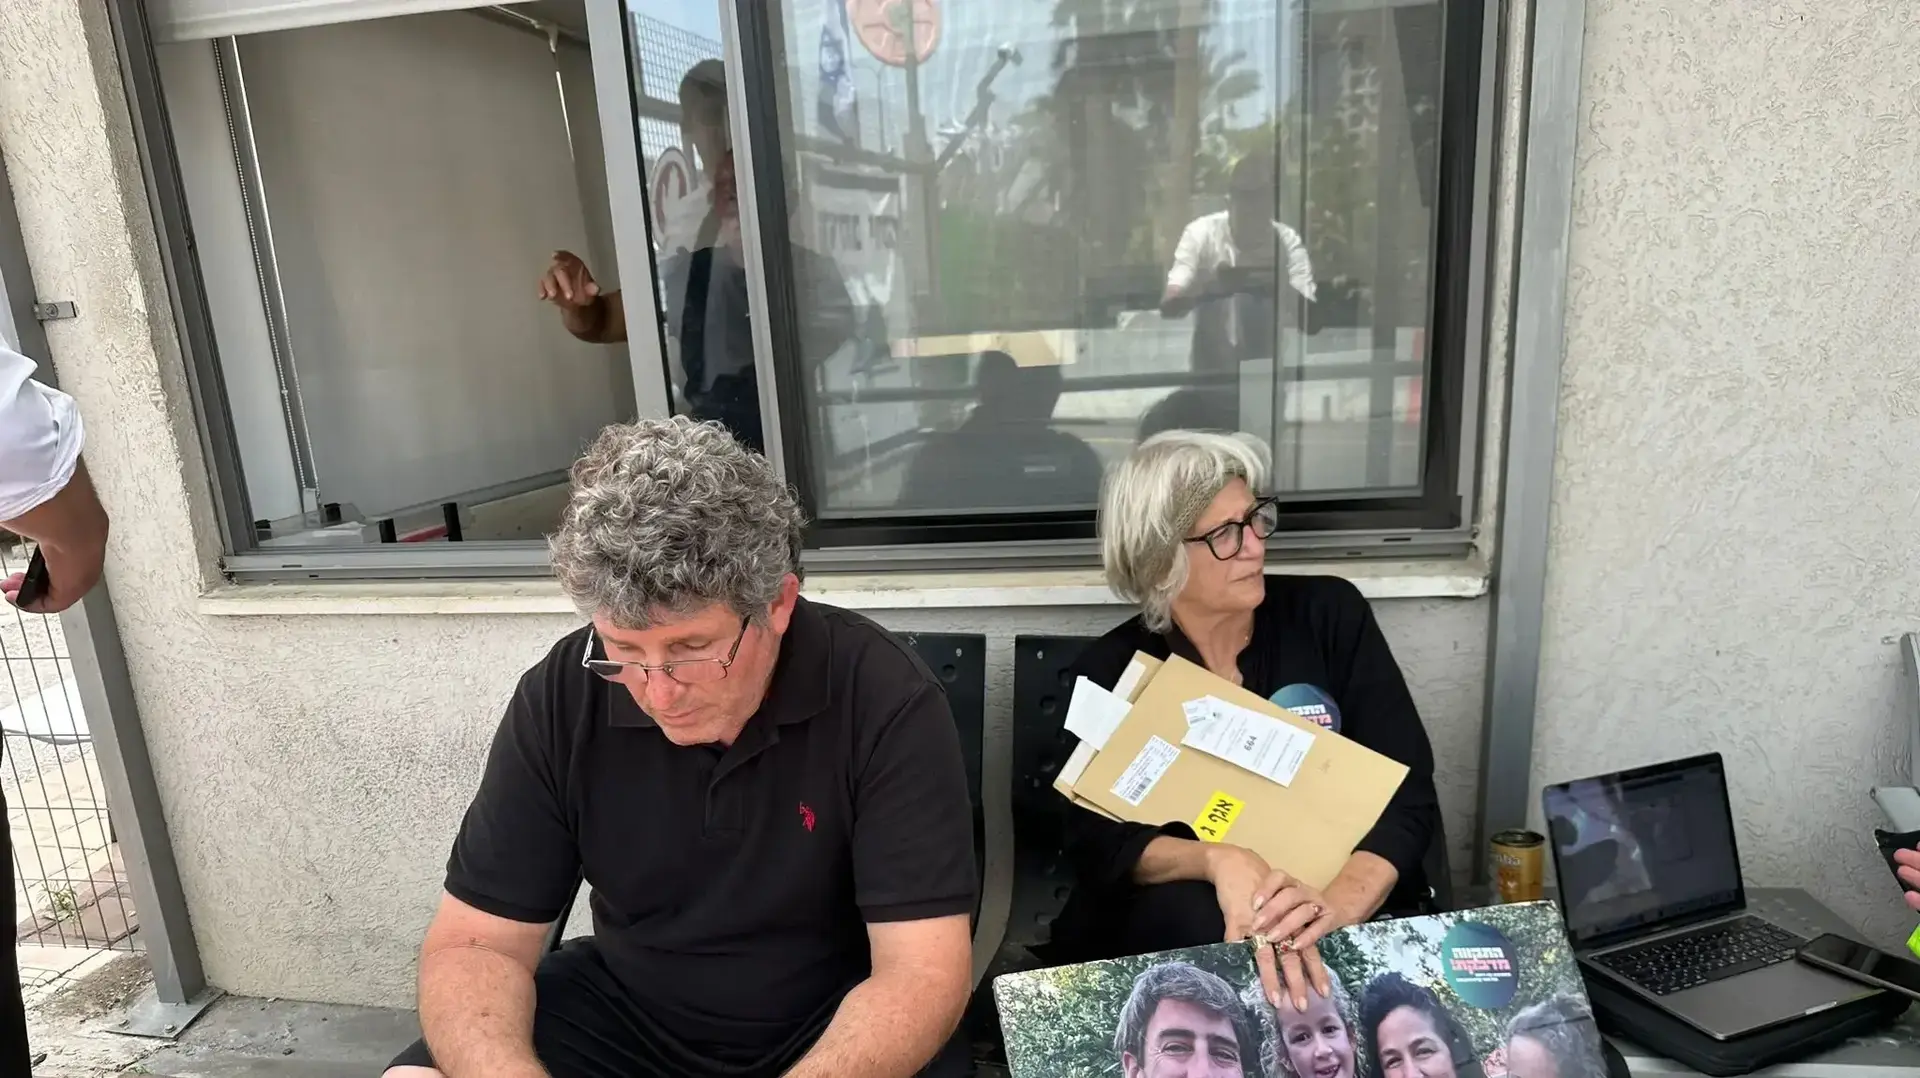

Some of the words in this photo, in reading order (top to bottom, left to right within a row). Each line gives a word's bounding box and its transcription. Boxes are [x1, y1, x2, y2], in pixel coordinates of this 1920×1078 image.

[1243, 735, 1257, 751] 664
[1207, 799, 1234, 823] אגף
[1200, 825, 1217, 837] ג
